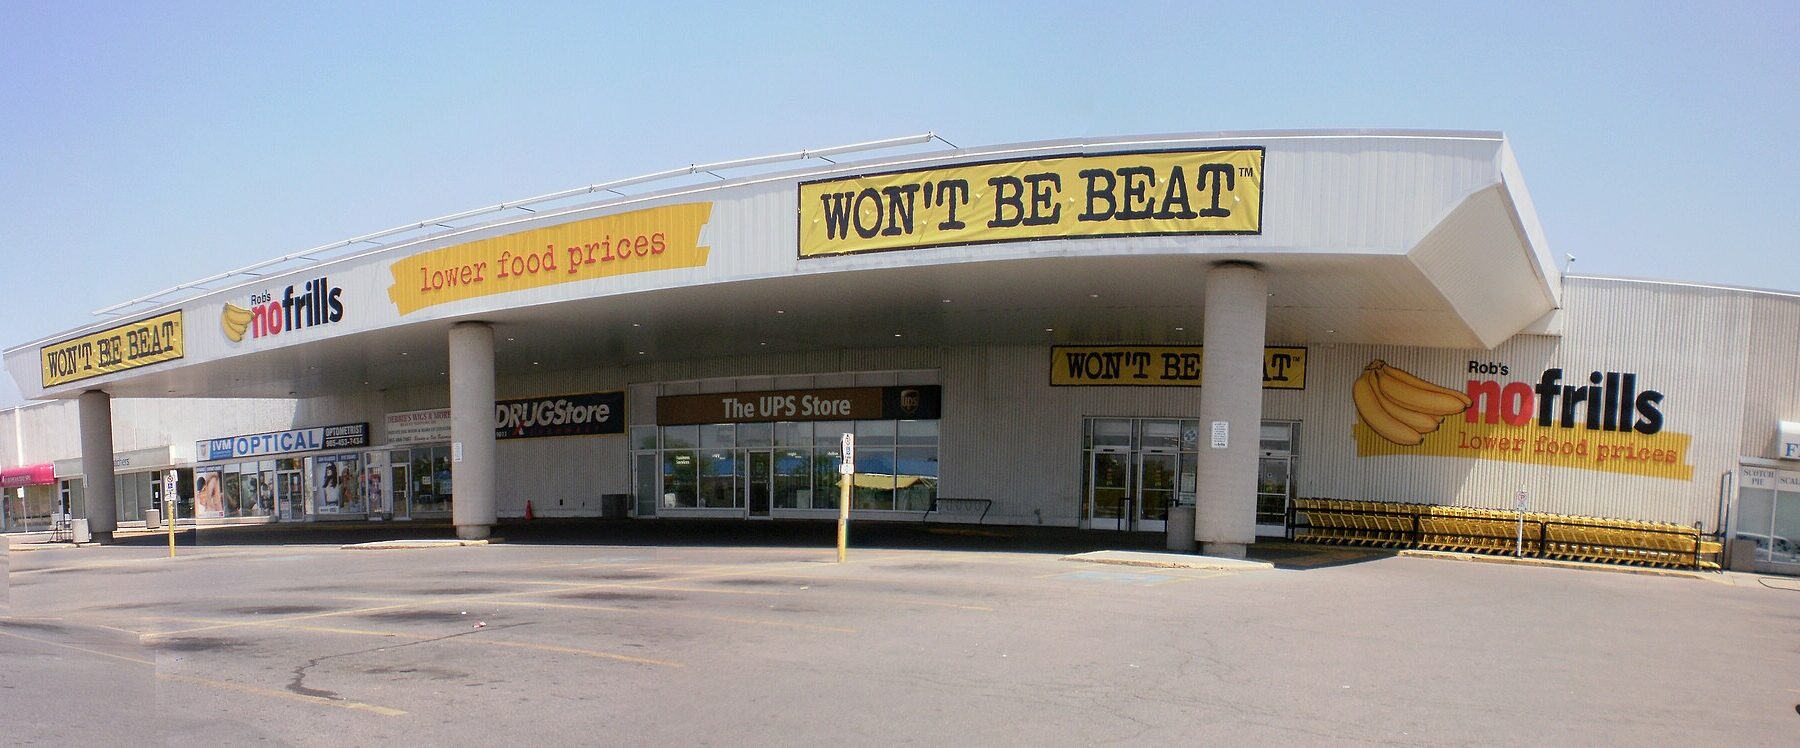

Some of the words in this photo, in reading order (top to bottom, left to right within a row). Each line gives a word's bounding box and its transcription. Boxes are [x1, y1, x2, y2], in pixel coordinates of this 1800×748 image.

[820, 178, 968, 240] WON'T
[988, 170, 1062, 228] BE
[1077, 163, 1235, 222] BEAT
[420, 261, 487, 293] lower
[497, 244, 558, 279] food
[567, 231, 667, 275] prices
[251, 289, 271, 305] Rob's
[47, 342, 92, 378] WON'T
[96, 335, 122, 368] BE
[126, 320, 174, 361] BEAT
[1066, 351, 1151, 379] WON'T
[1160, 352, 1201, 380] BE
[1468, 360, 1509, 376] Rob's
[412, 412, 427, 422] WIGS
[722, 397, 754, 419] The
[759, 395, 796, 417] UPS
[801, 394, 851, 416] Store
[212, 439, 232, 452] IVM
[236, 430, 320, 455] OPTICAL
[325, 425, 362, 436] OPTOMETRIST
[1458, 432, 1526, 452] lower
[1534, 436, 1588, 457] food
[1596, 441, 1677, 465] prices
[1743, 469, 1774, 479] SCOTCH
[1752, 477, 1765, 486] PIE
